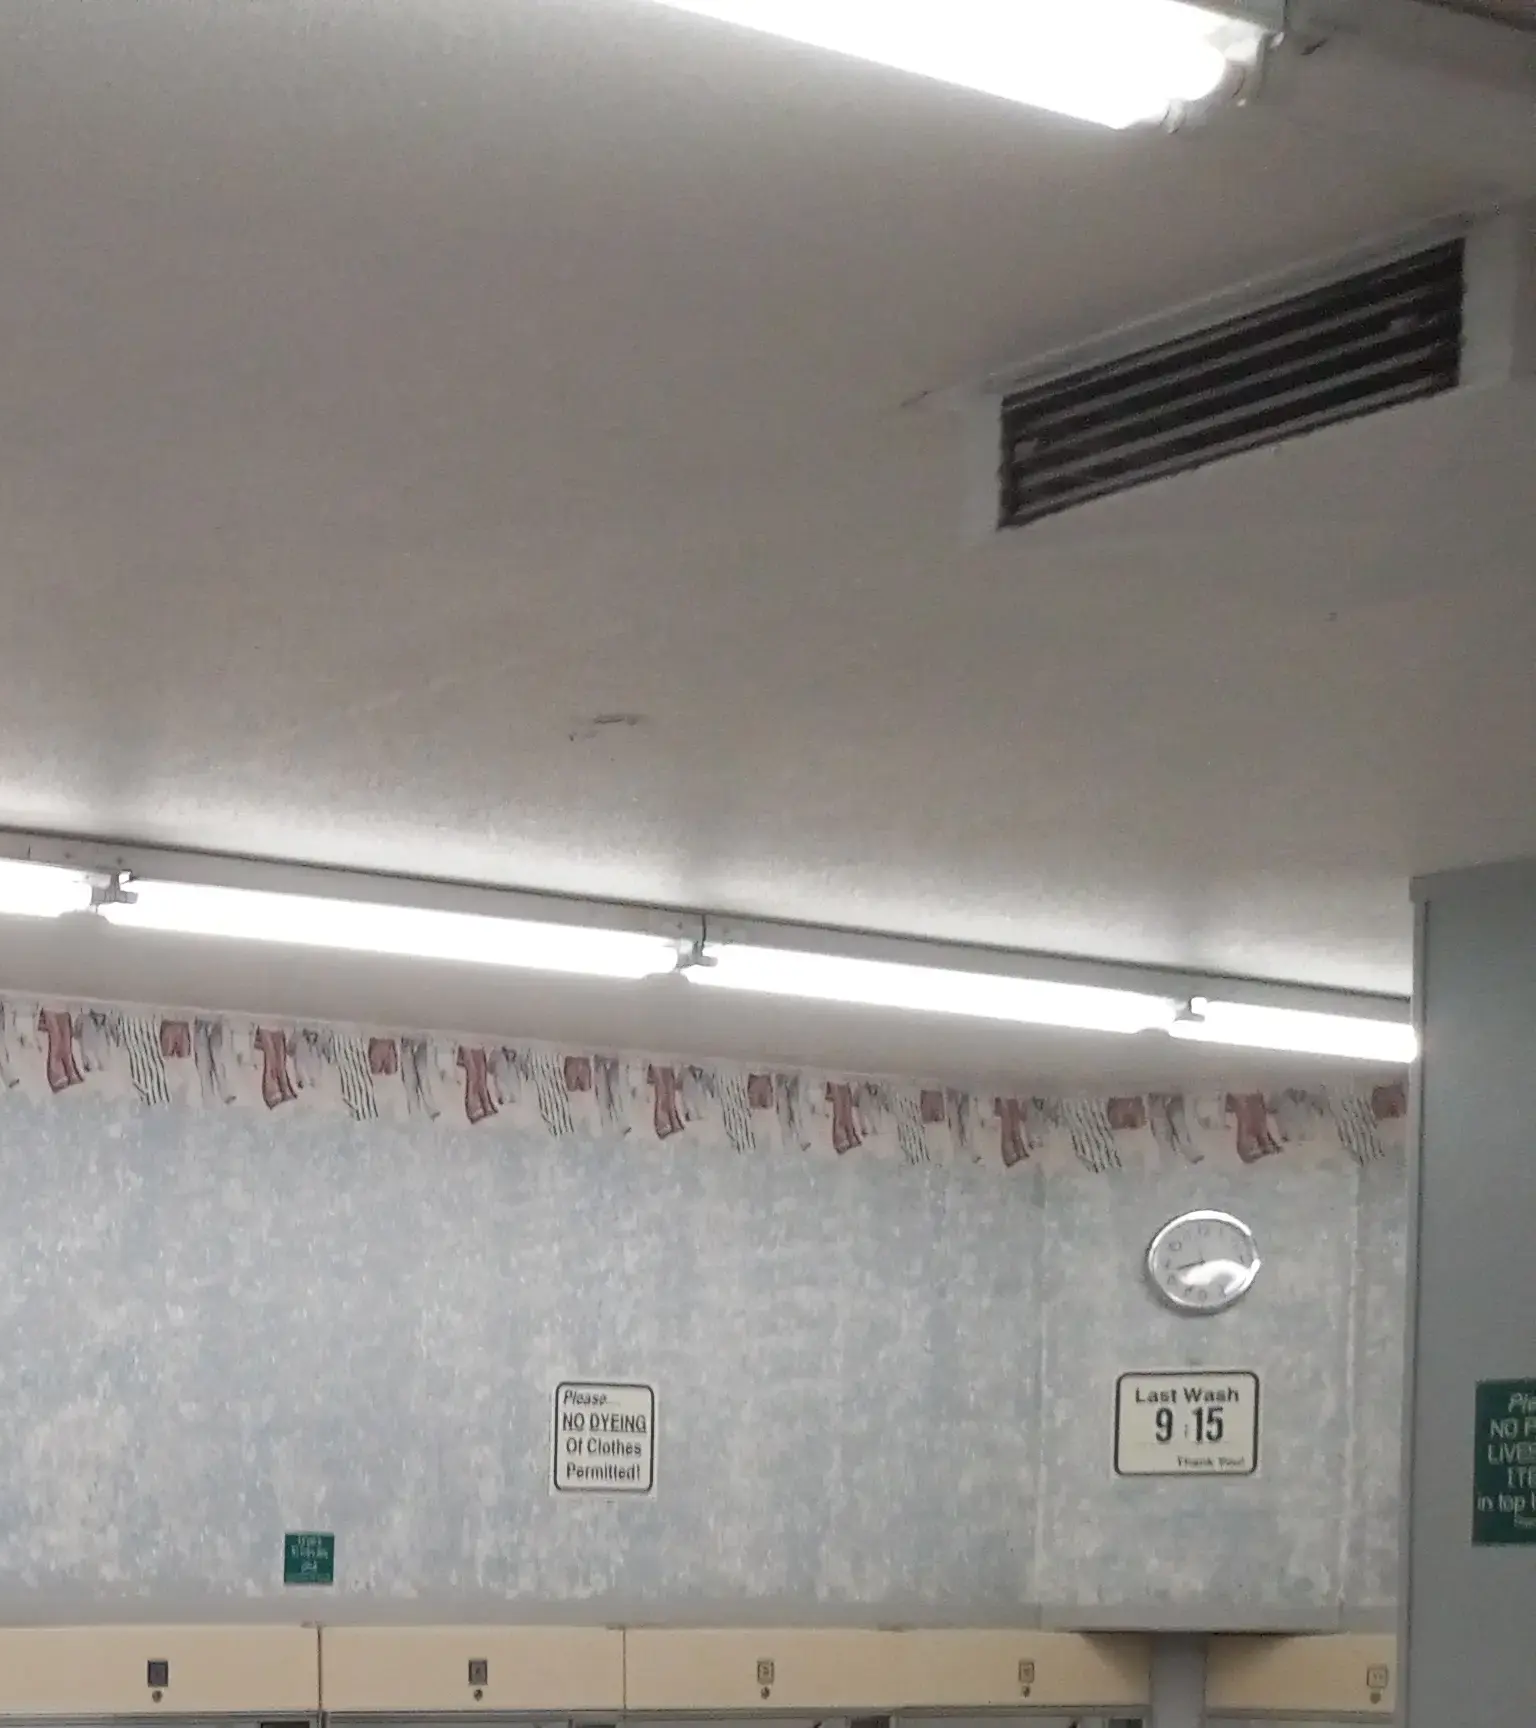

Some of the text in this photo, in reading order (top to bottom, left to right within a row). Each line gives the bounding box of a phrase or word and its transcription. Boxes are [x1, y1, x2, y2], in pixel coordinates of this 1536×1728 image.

[1134, 1385, 1240, 1404] Last Wash
[562, 1411, 647, 1433] NO DYEING
[1154, 1405, 1224, 1444] 9 15
[1489, 1418, 1518, 1440] NO
[565, 1436, 643, 1457] Of Clothes
